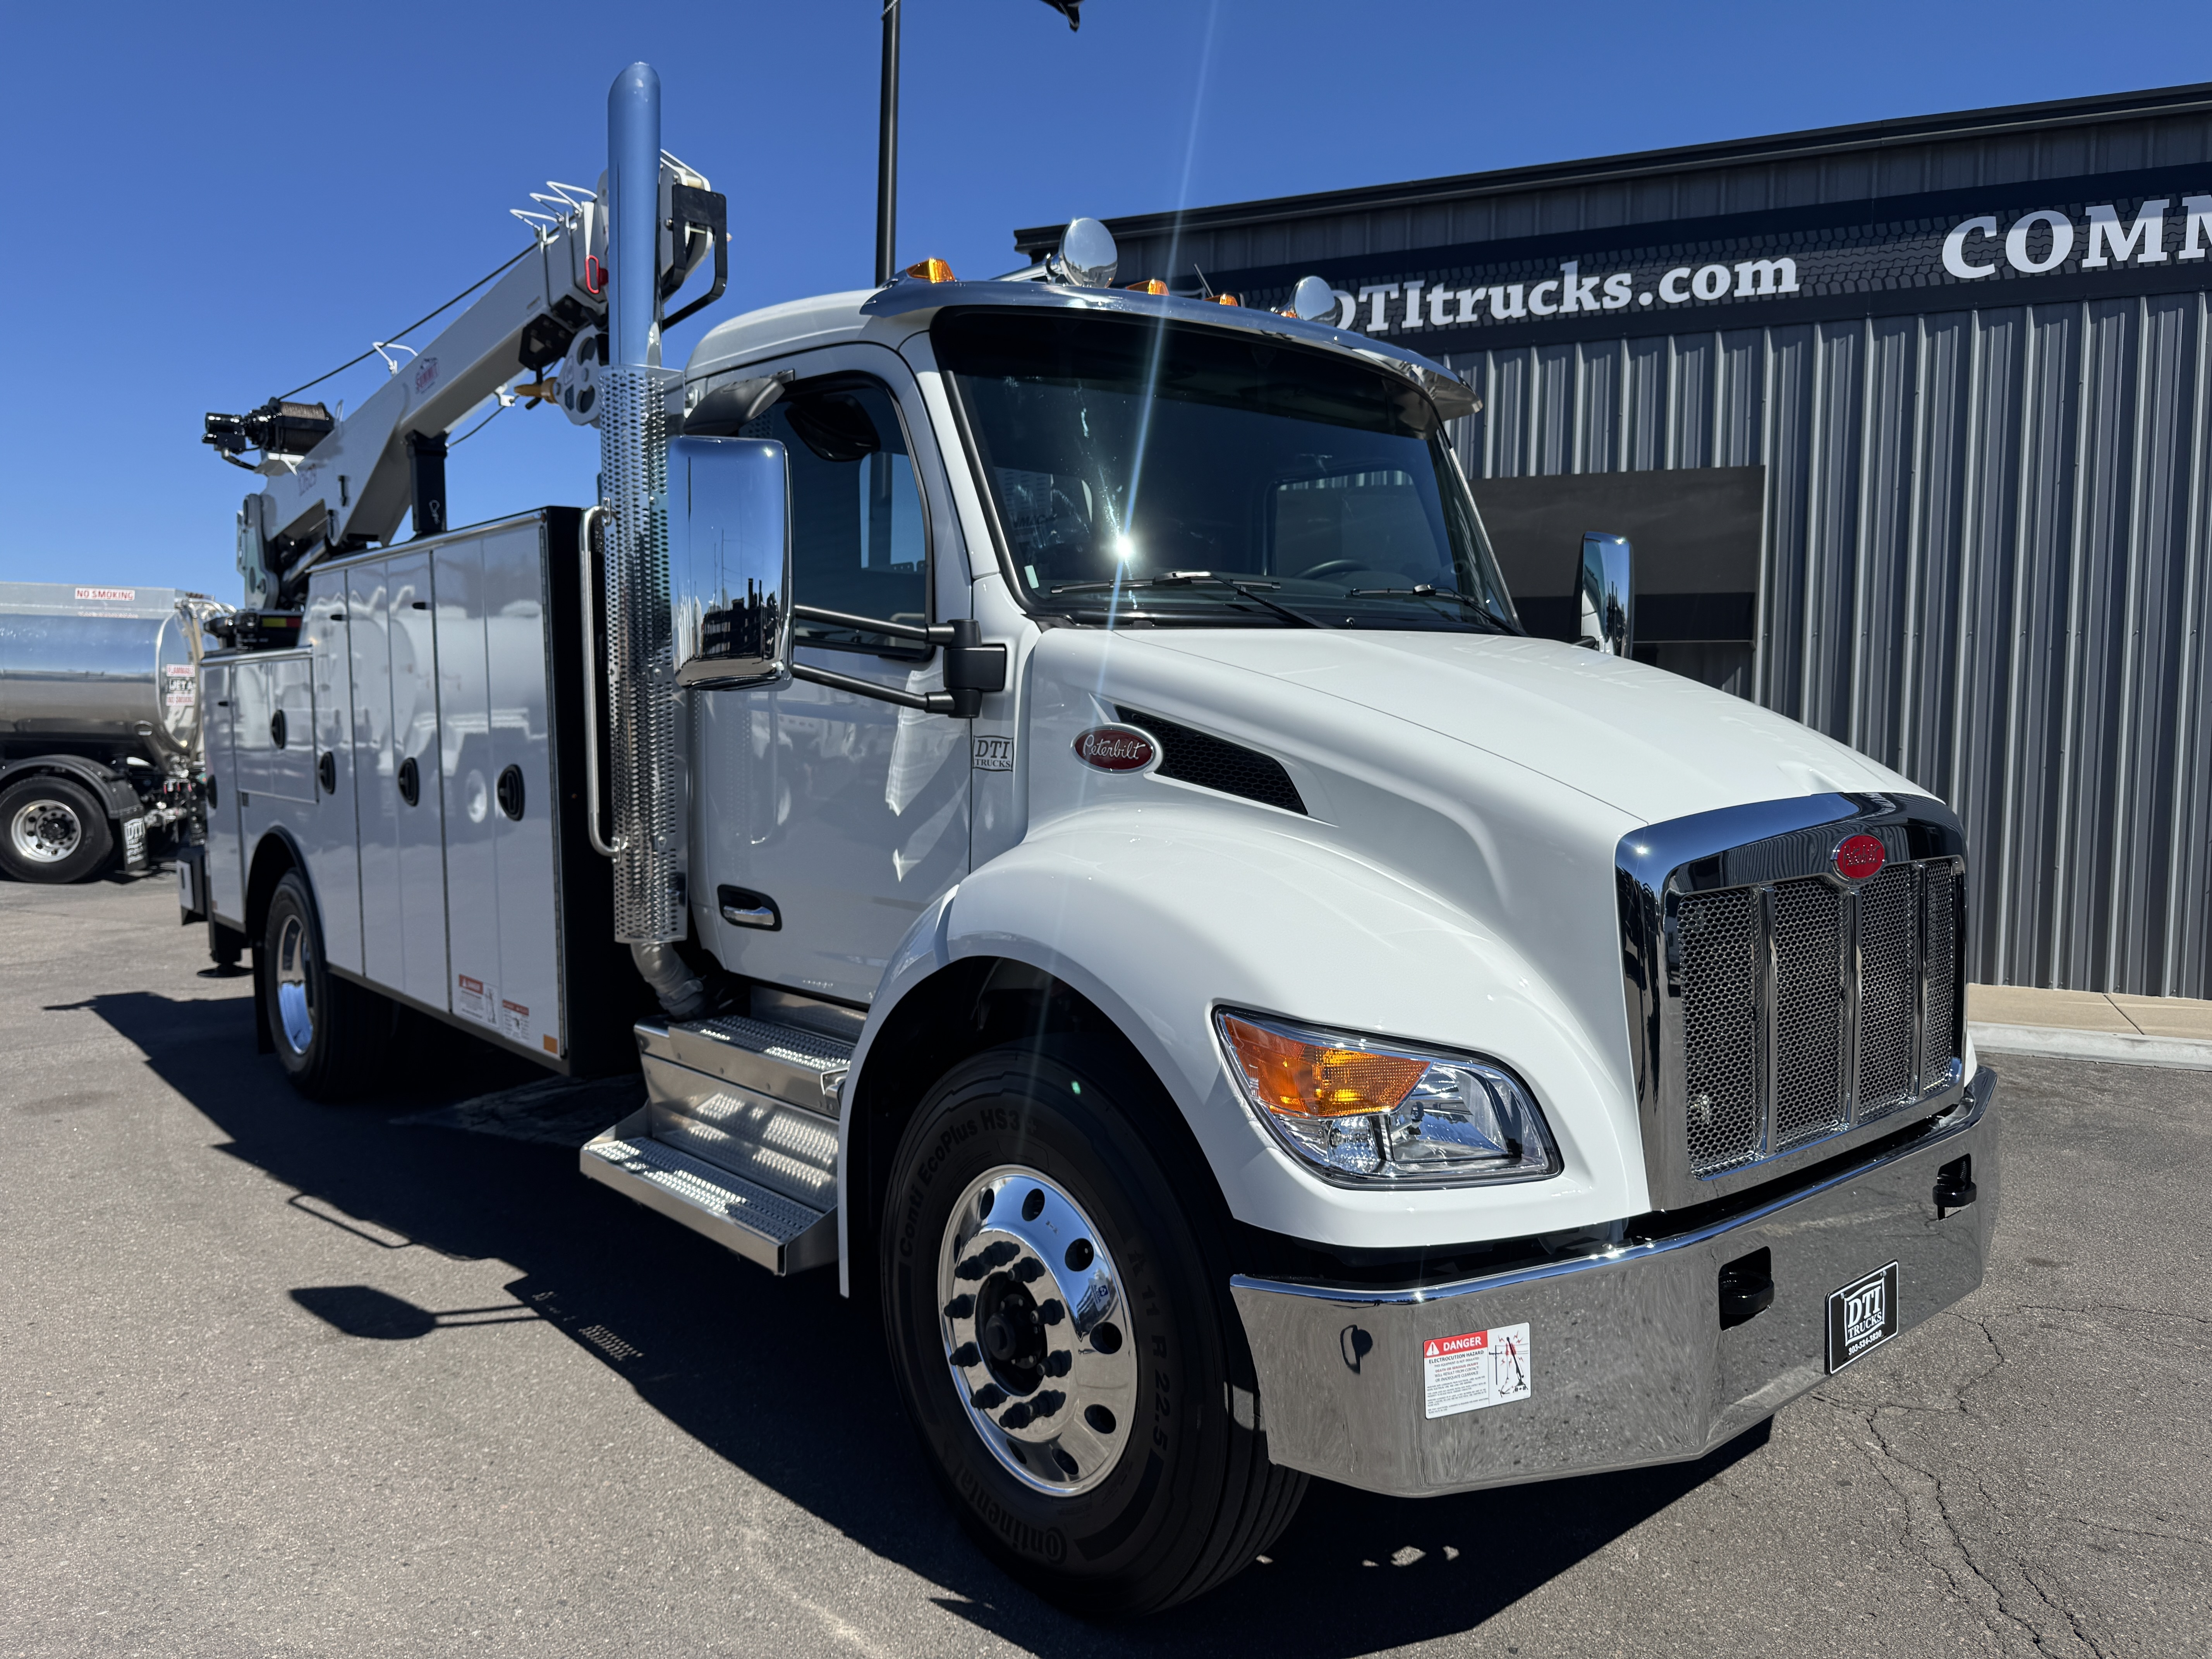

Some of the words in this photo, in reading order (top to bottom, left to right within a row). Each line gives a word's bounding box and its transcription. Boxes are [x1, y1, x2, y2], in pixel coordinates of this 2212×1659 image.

[92, 591, 134, 600] SMOKING
[170, 680, 187, 690] JET
[975, 740, 1010, 759] DTI
[1082, 734, 1146, 759] Peterbilt
[975, 759, 1011, 768] TRUCKS
[900, 1184, 924, 1258] Conti
[917, 1119, 978, 1186] EcoPlus
[1848, 1286, 1881, 1328] DTI
[1848, 1311, 1882, 1339] TRUCKS
[1443, 1336, 1482, 1352] DANGER
[1848, 1329, 1882, 1356] 303-524-3820
[1429, 1354, 1465, 1364] ELECTROCUTION
